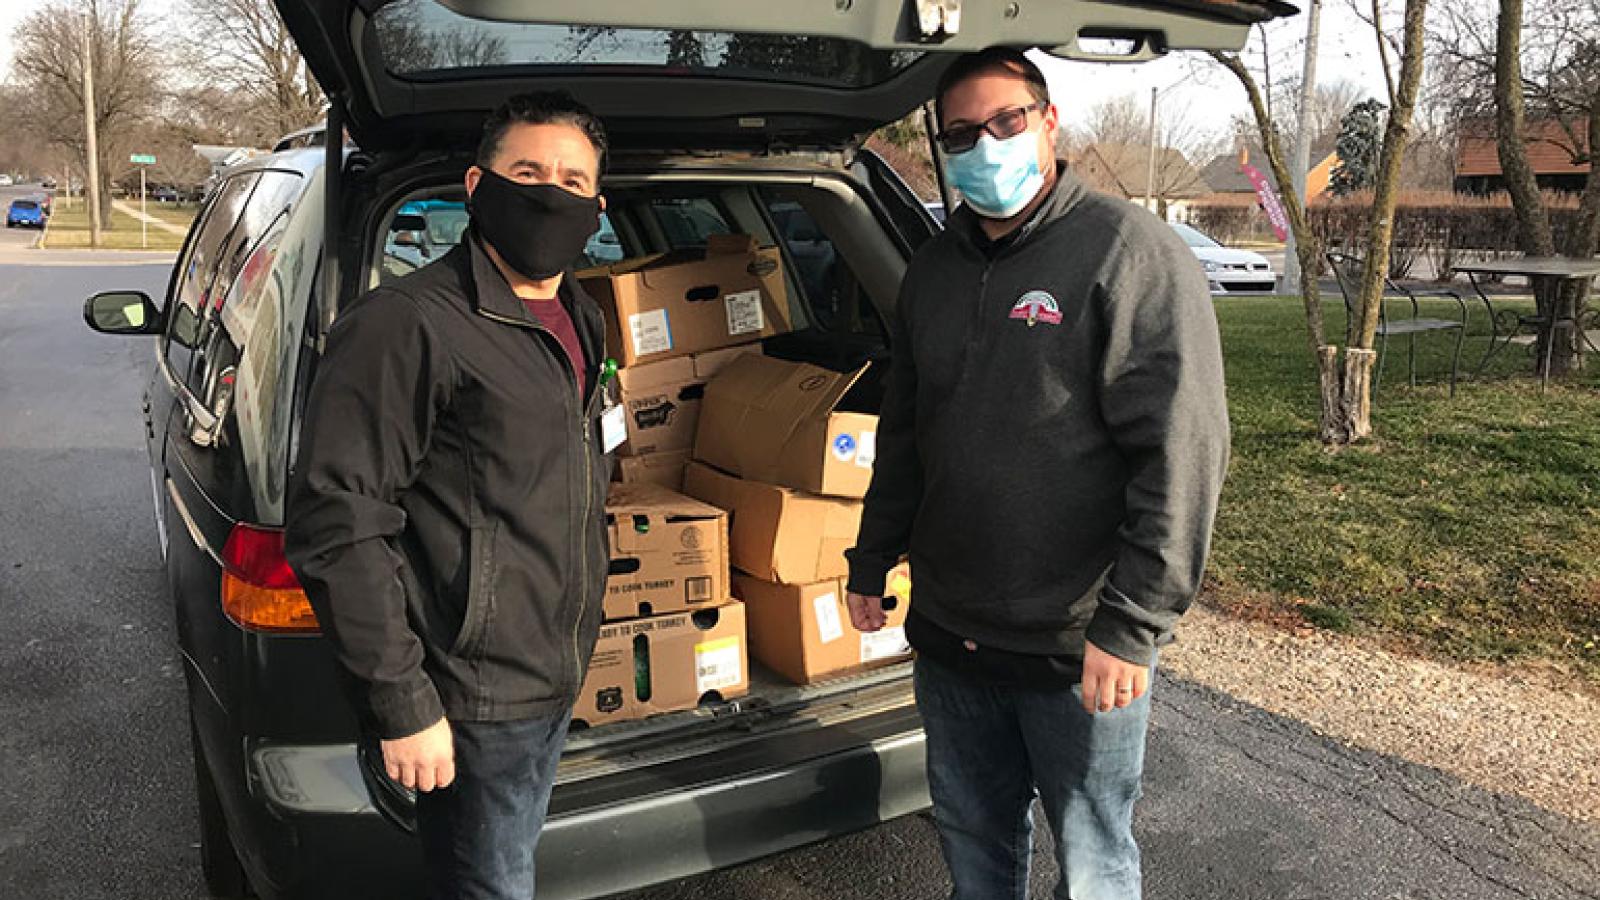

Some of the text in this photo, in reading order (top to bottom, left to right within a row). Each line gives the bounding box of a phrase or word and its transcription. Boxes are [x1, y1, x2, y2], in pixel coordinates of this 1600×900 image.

[609, 580, 674, 594] TO COOK TURKEY
[633, 622, 653, 633] COOK
[657, 616, 686, 628] TURKEY
